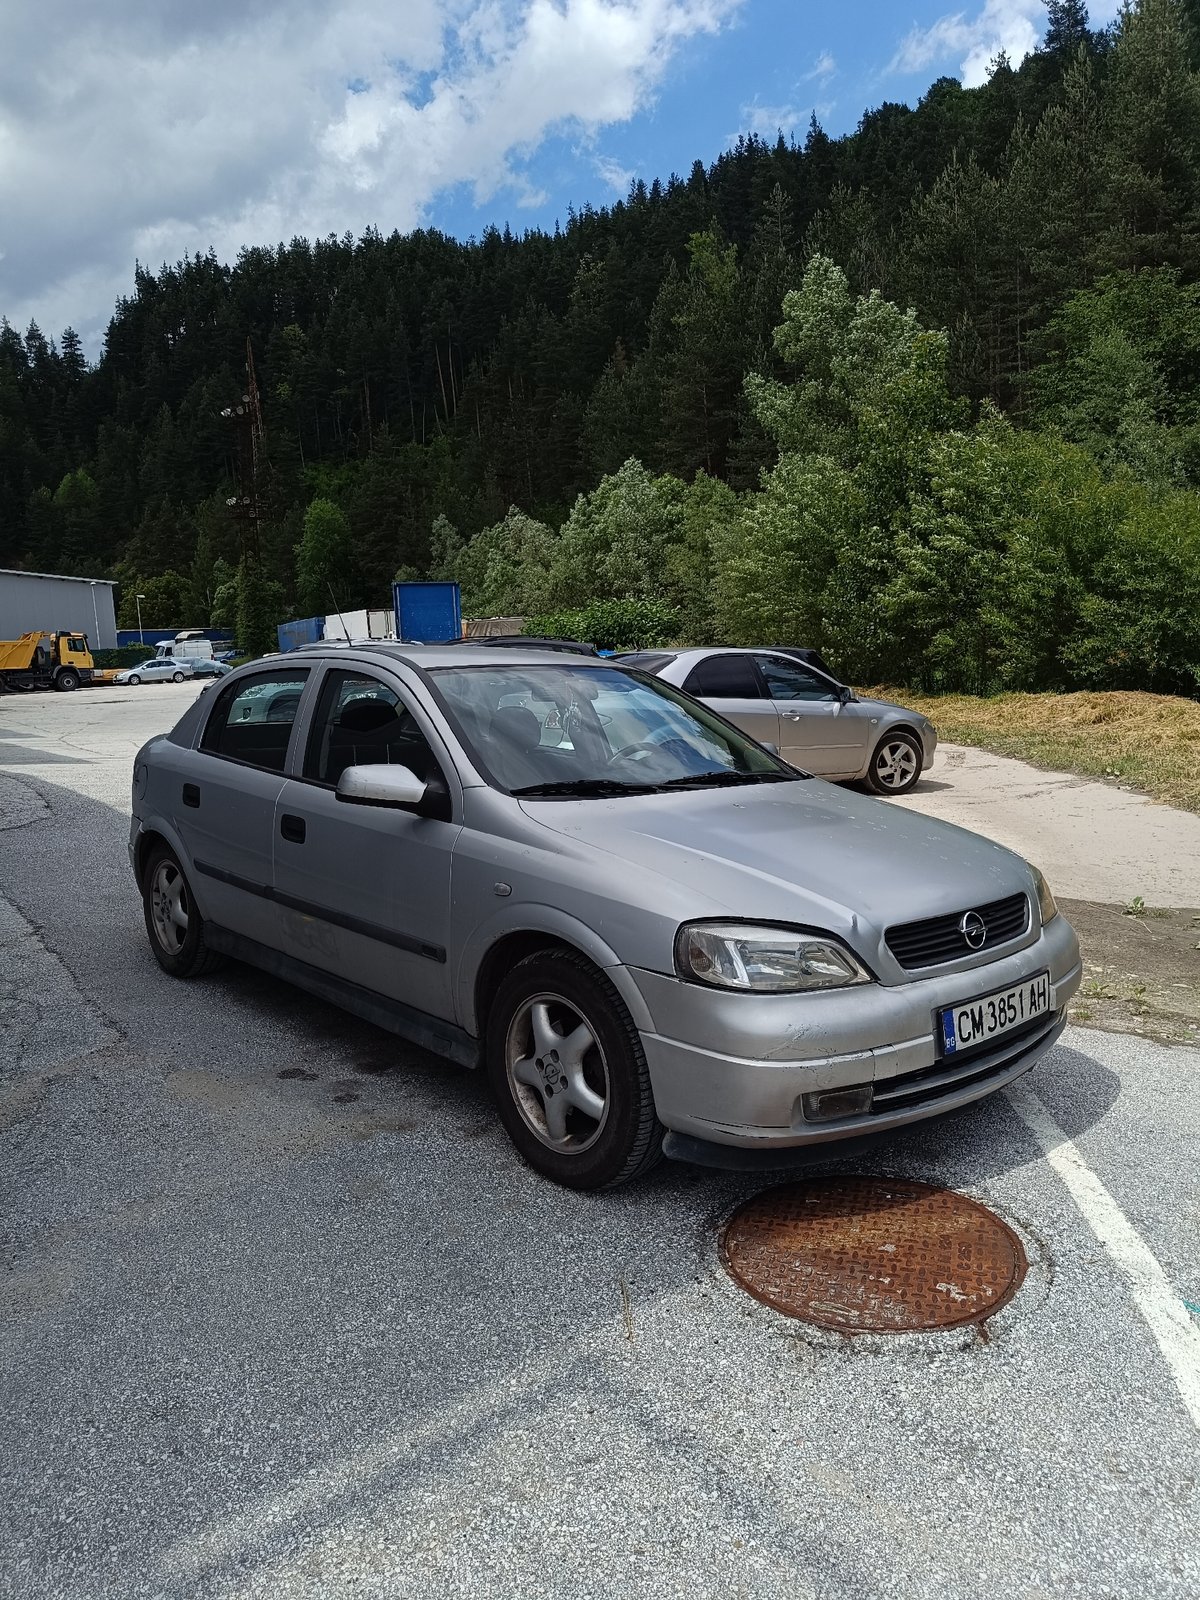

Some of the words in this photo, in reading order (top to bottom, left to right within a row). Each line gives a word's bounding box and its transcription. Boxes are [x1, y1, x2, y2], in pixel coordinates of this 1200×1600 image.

[958, 1005, 984, 1043] CM
[987, 989, 1024, 1032] 3851
[1029, 978, 1046, 1015] AH
[946, 1036, 956, 1048] BG
